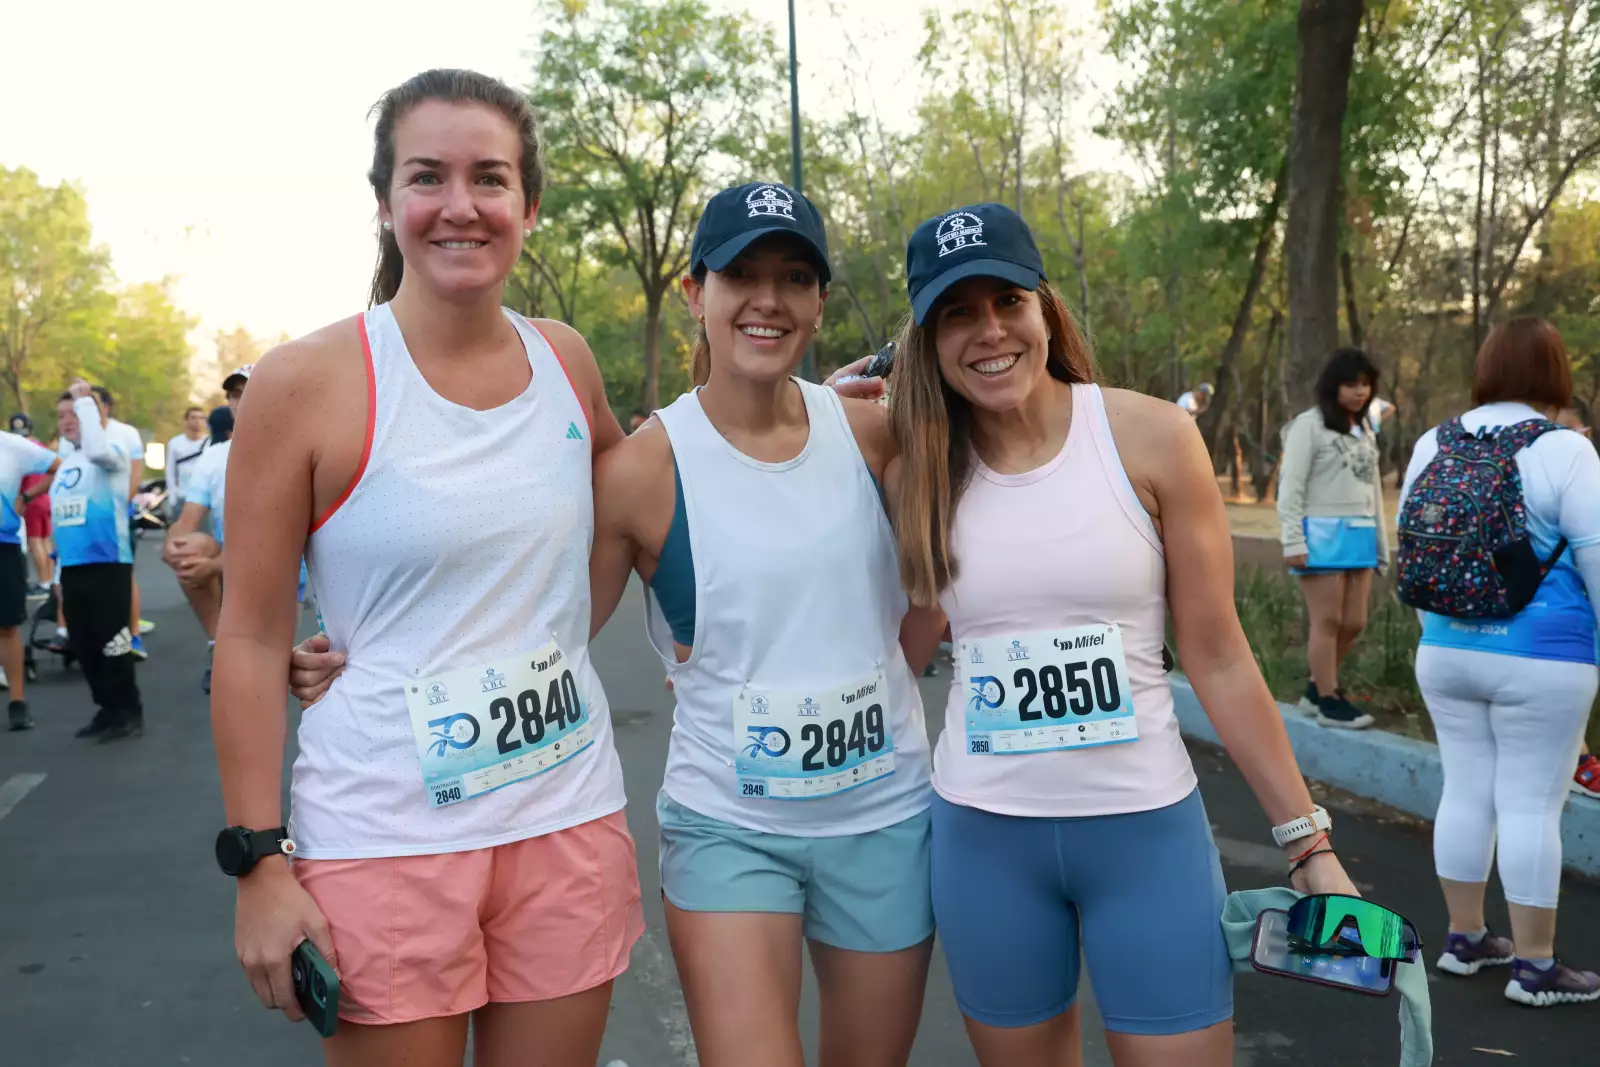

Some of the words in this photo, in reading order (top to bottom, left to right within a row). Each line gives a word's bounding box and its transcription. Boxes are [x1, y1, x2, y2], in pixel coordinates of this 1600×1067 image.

[1074, 633, 1105, 649] Mifel
[856, 682, 877, 700] Mifel
[1013, 657, 1121, 722] 2850
[489, 669, 581, 755] 2840
[801, 703, 885, 771] 2849
[971, 741, 991, 753] 2850
[435, 787, 462, 804] 2840
[742, 783, 764, 796] 2849
